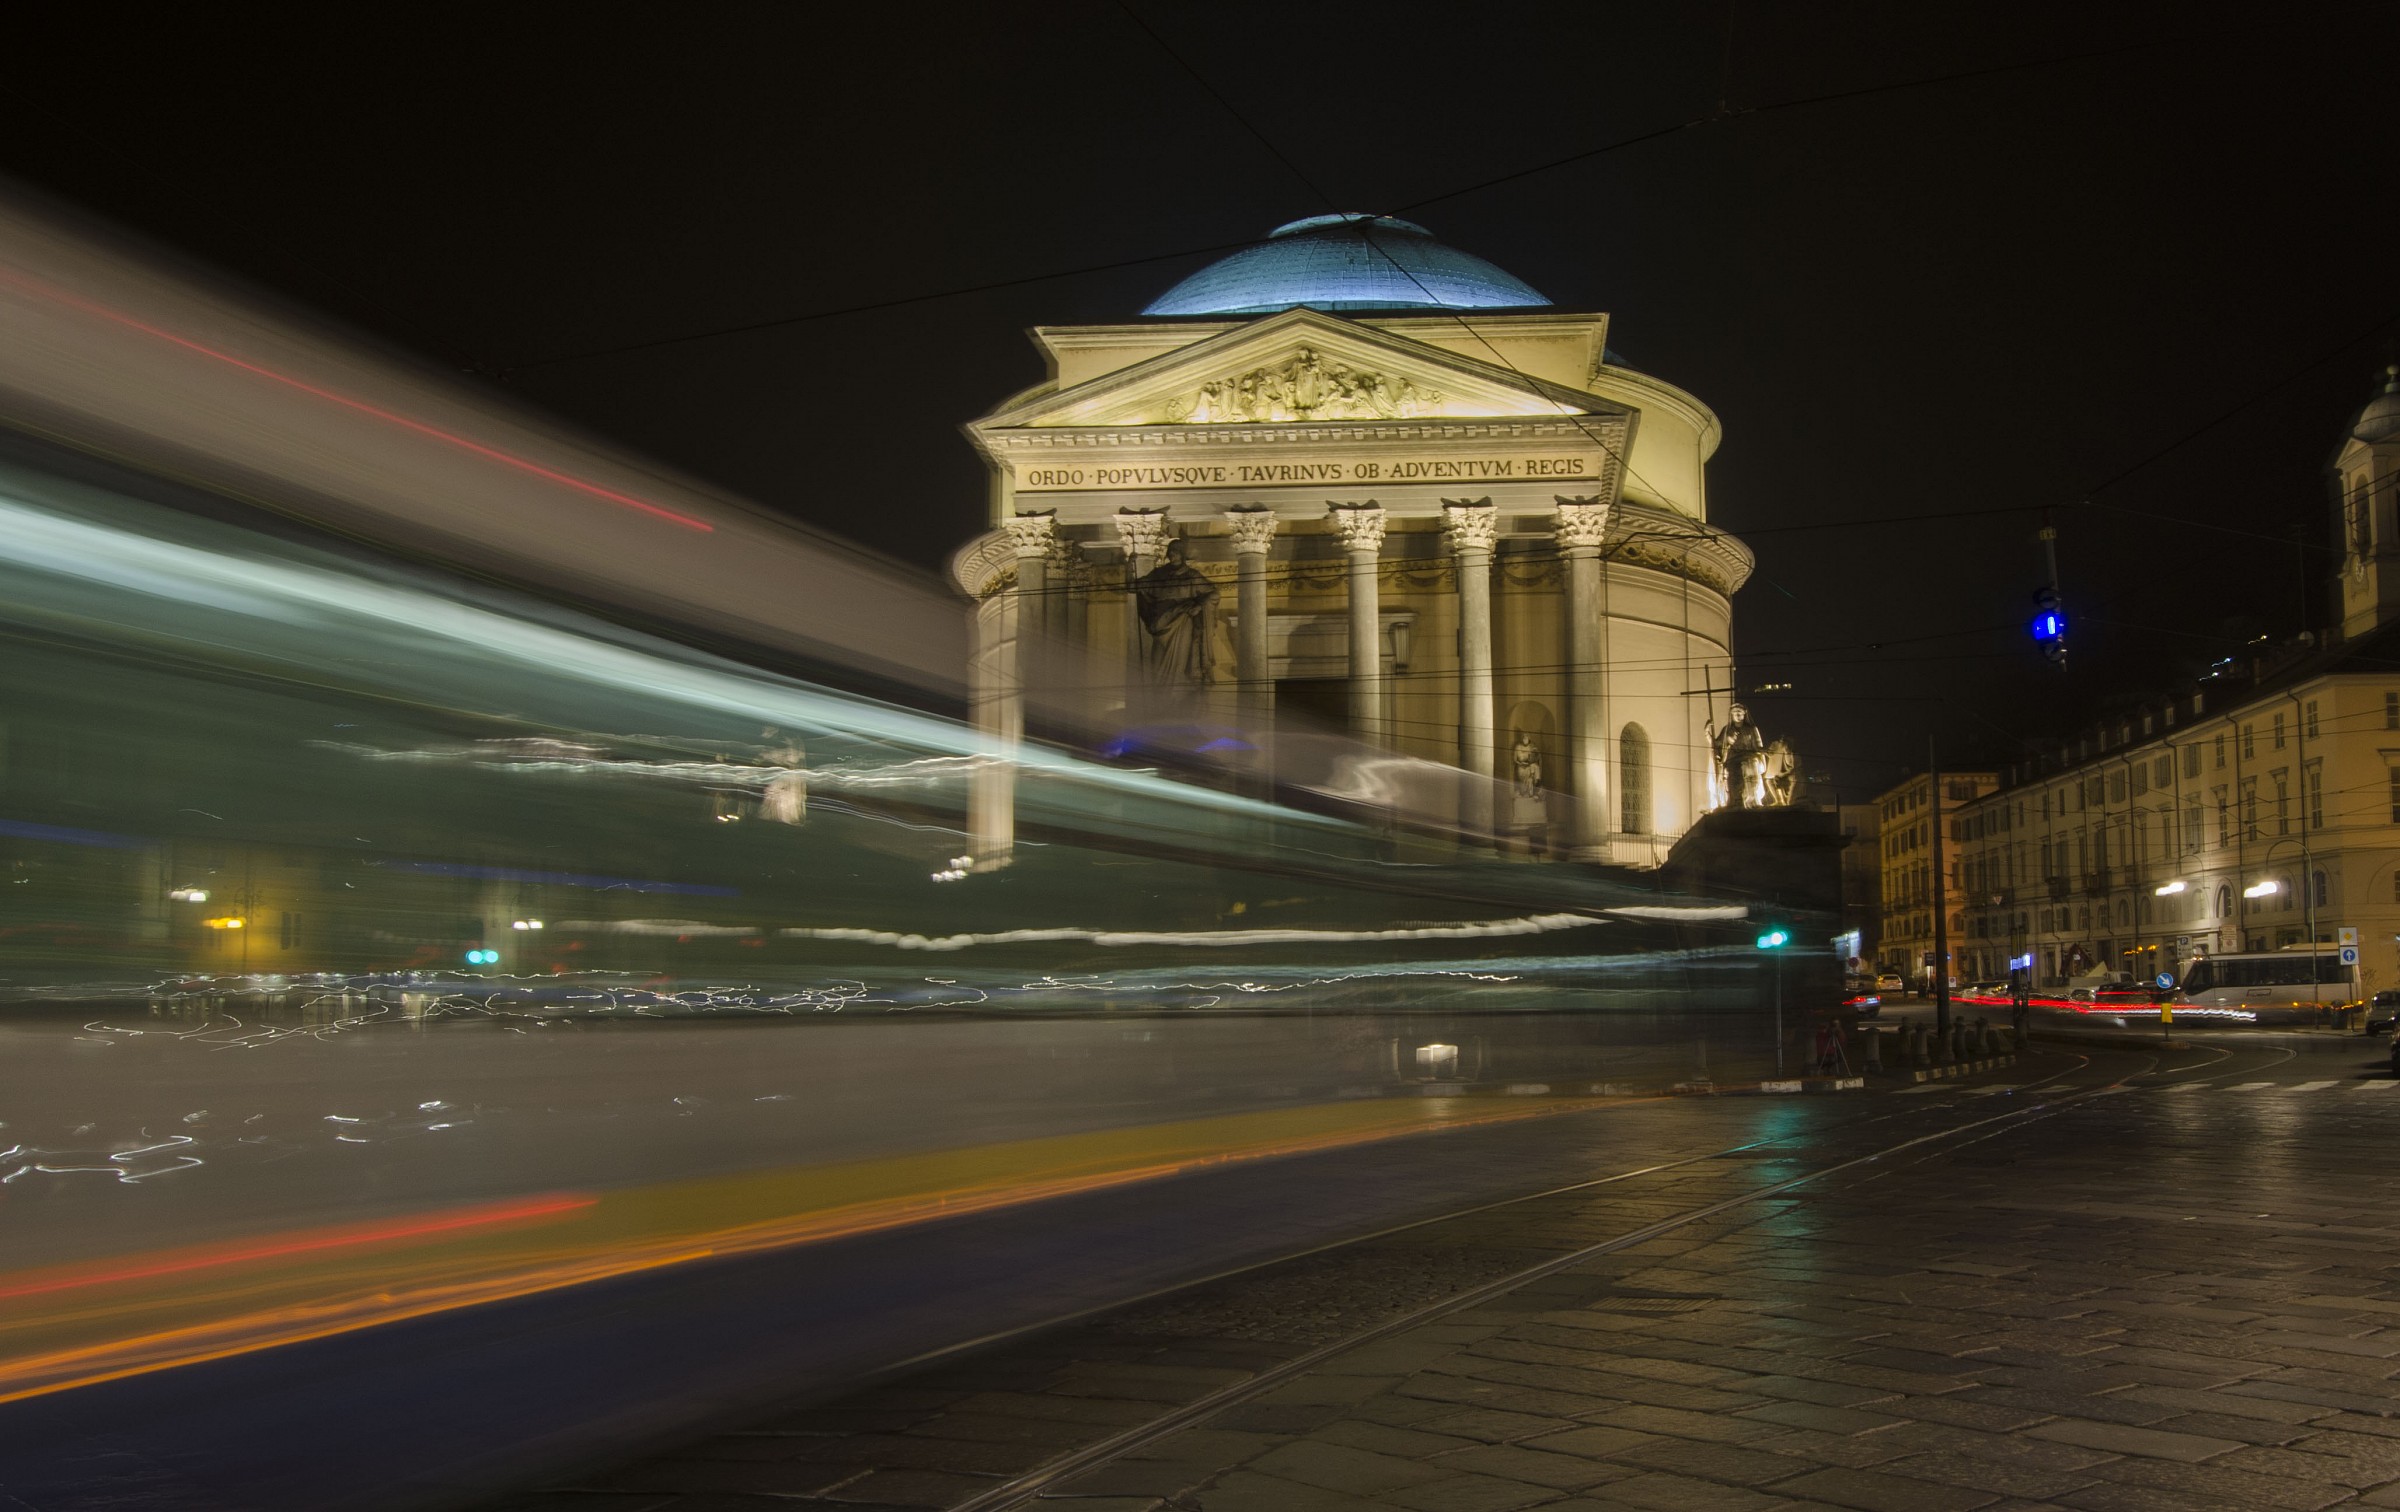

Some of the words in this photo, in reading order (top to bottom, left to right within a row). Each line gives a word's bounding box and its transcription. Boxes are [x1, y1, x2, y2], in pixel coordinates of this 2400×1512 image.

[1029, 470, 1084, 485] ORDO
[1096, 467, 1226, 484] POPVLVSQVE
[1238, 464, 1342, 481] TAVRINVS
[1354, 463, 1379, 478] OB
[1389, 460, 1512, 477] ADVENTVM
[1525, 459, 1584, 474] REGIS
